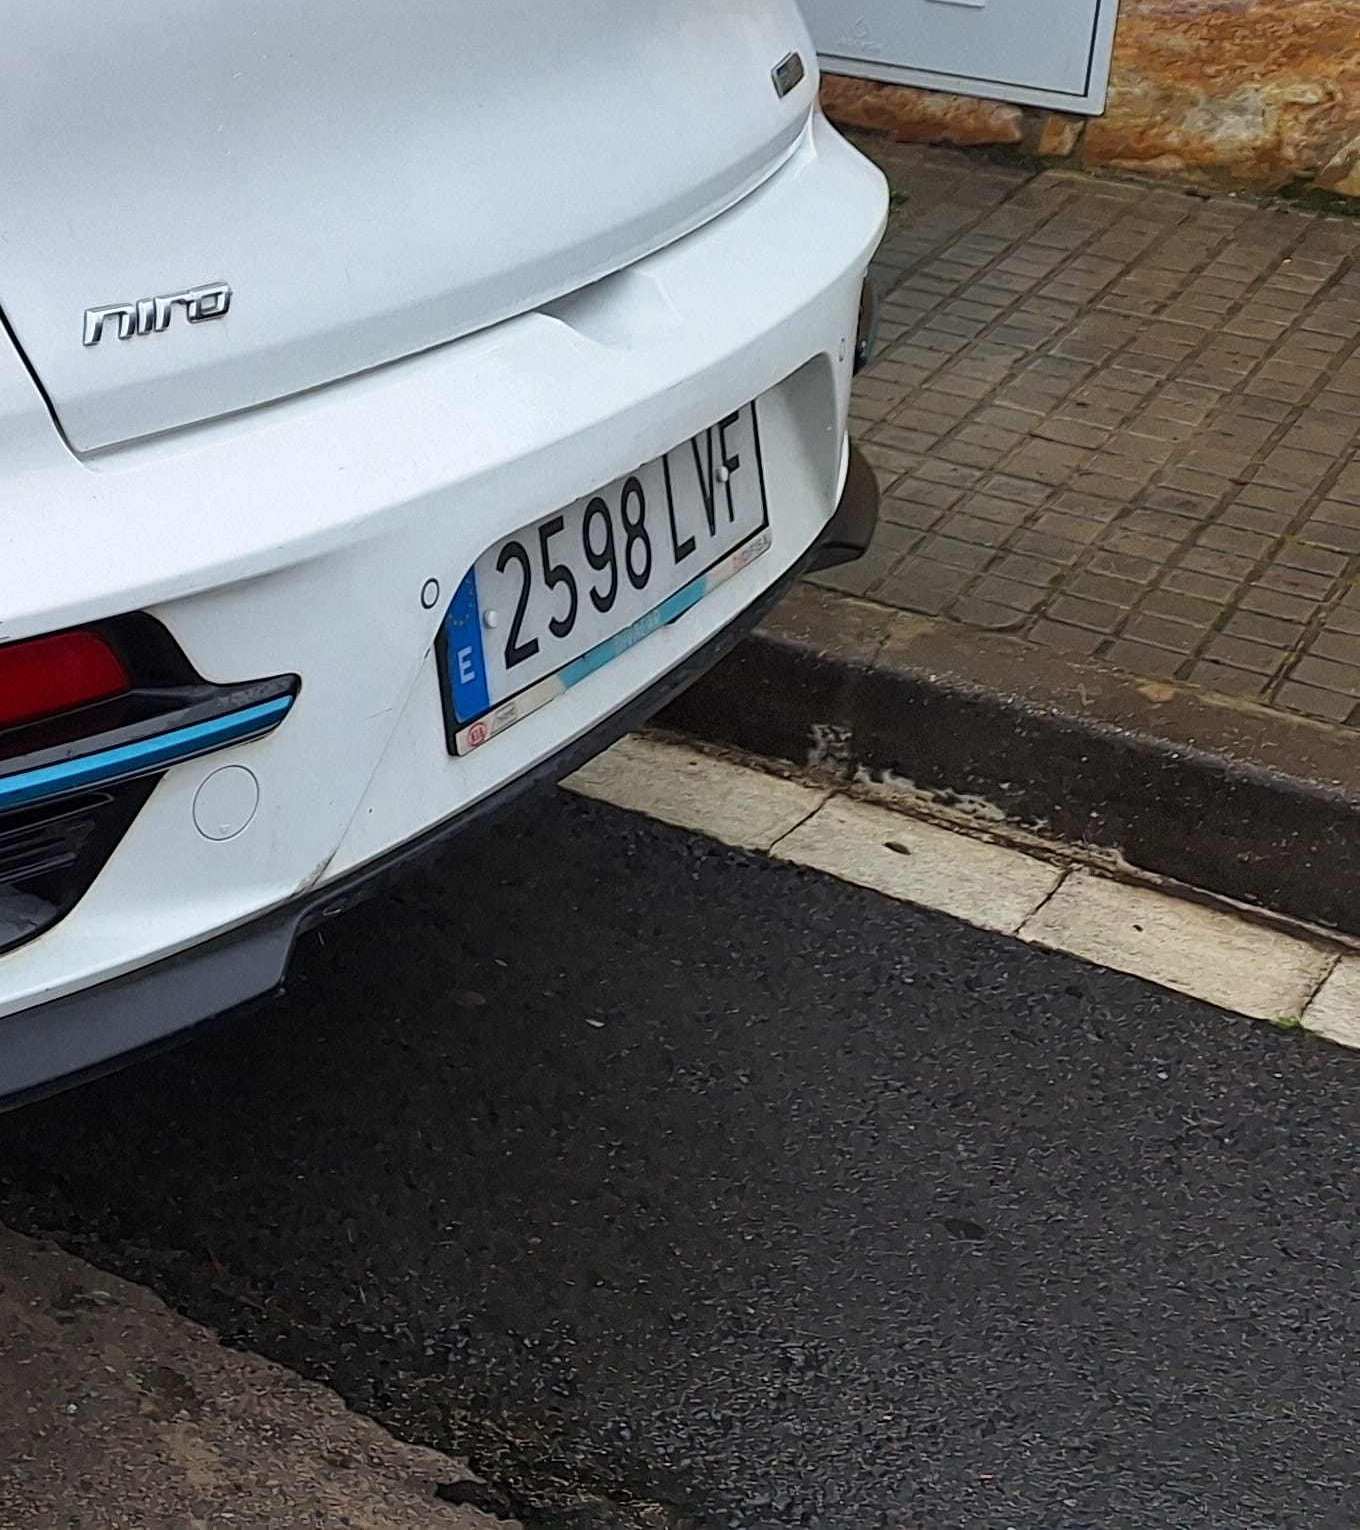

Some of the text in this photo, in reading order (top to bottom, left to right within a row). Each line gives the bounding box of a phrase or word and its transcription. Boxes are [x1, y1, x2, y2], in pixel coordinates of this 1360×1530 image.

[495, 409, 740, 671] 2598 LVF
[456, 645, 475, 685] E
